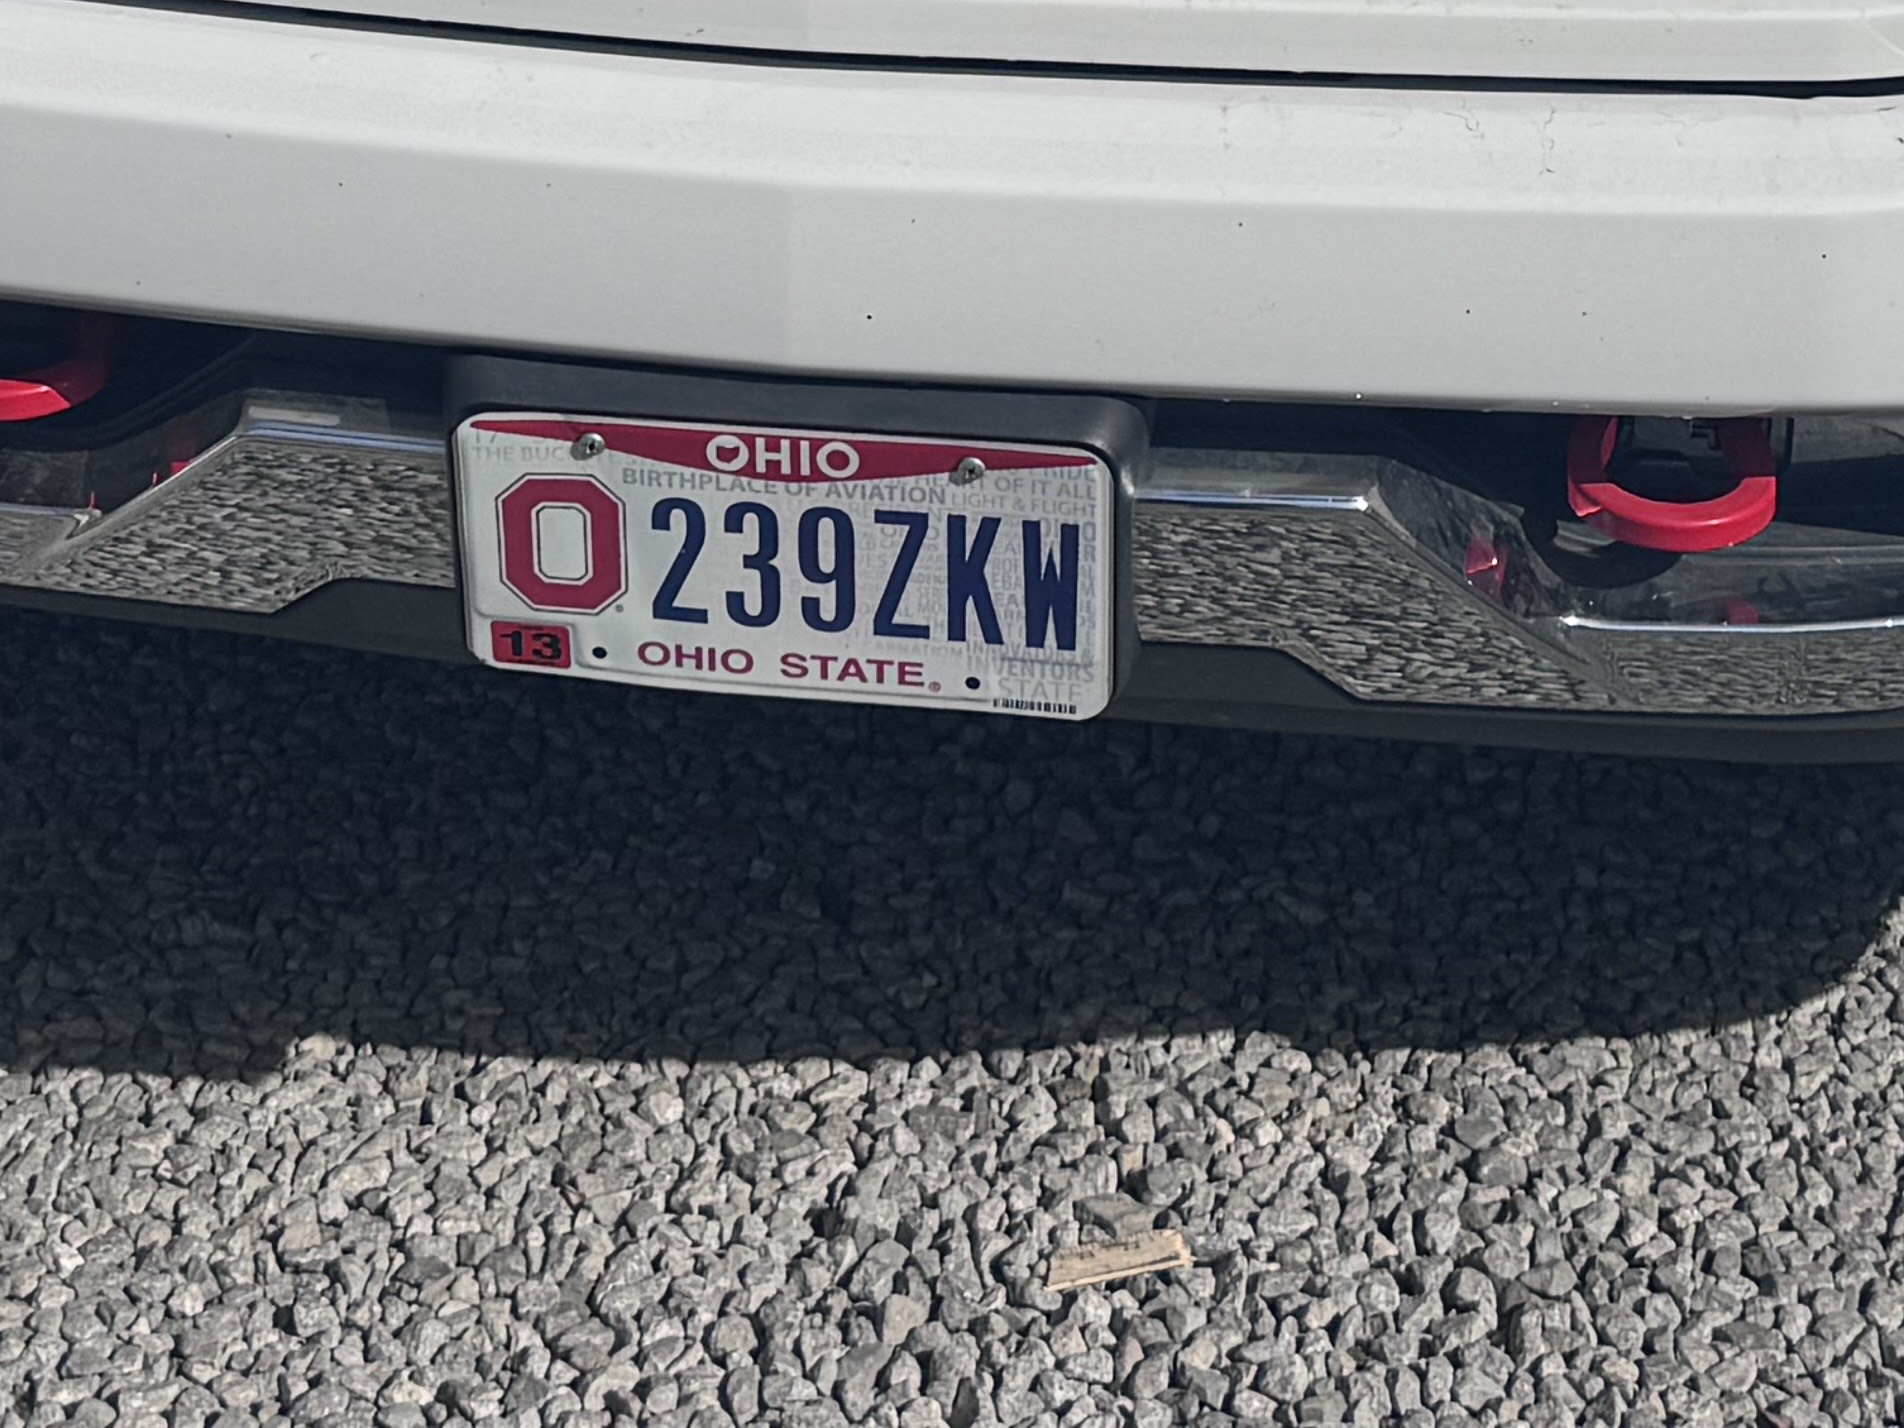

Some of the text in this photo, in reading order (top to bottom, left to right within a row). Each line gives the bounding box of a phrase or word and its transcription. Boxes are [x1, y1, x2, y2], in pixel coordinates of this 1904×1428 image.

[706, 434, 860, 479] OHIO
[623, 467, 945, 506] BIRTHPLACE OF AVIATION
[651, 497, 1080, 651] 239ZKW
[500, 631, 562, 660] 13
[637, 641, 754, 674] OHIO
